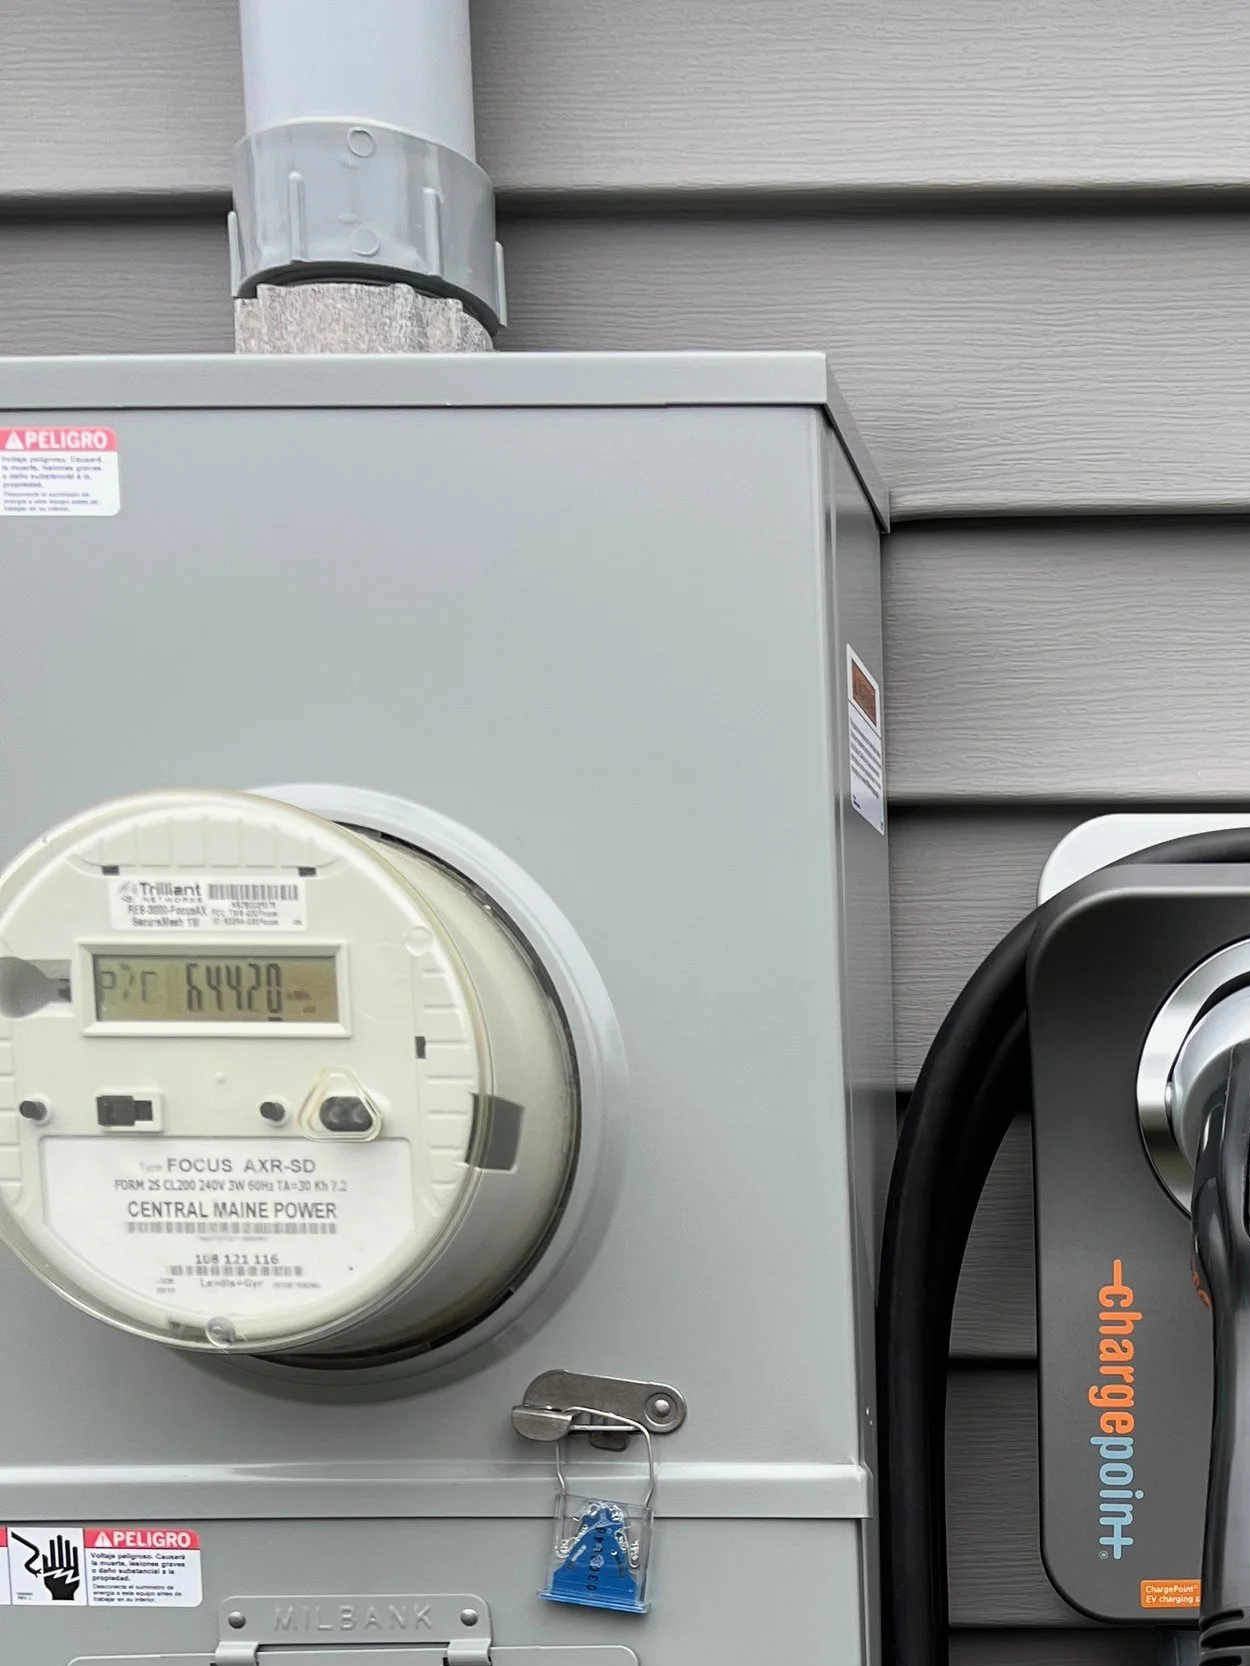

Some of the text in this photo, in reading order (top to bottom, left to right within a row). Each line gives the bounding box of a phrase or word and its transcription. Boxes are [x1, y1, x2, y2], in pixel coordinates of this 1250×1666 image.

[25, 431, 108, 449] PELIGRO
[139, 882, 201, 896] Trilliant
[167, 1158, 233, 1173] FOCUS
[244, 1158, 316, 1173] AXR-SD
[114, 1179, 145, 1191] FORM
[163, 1179, 196, 1191] CL200
[199, 1179, 225, 1191] 240V
[228, 1180, 245, 1191] 3W
[128, 1201, 338, 1219] CENTRAL MAINE POWER
[224, 1254, 249, 1265] 121
[255, 1254, 279, 1265] 116
[113, 1531, 191, 1548] PELIGRO
[90, 1552, 115, 1560] Voltaje
[118, 1552, 153, 1560] peligroso.
[1158, 1595, 1194, 1604] charging
[273, 1605, 433, 1632] MILBANK
